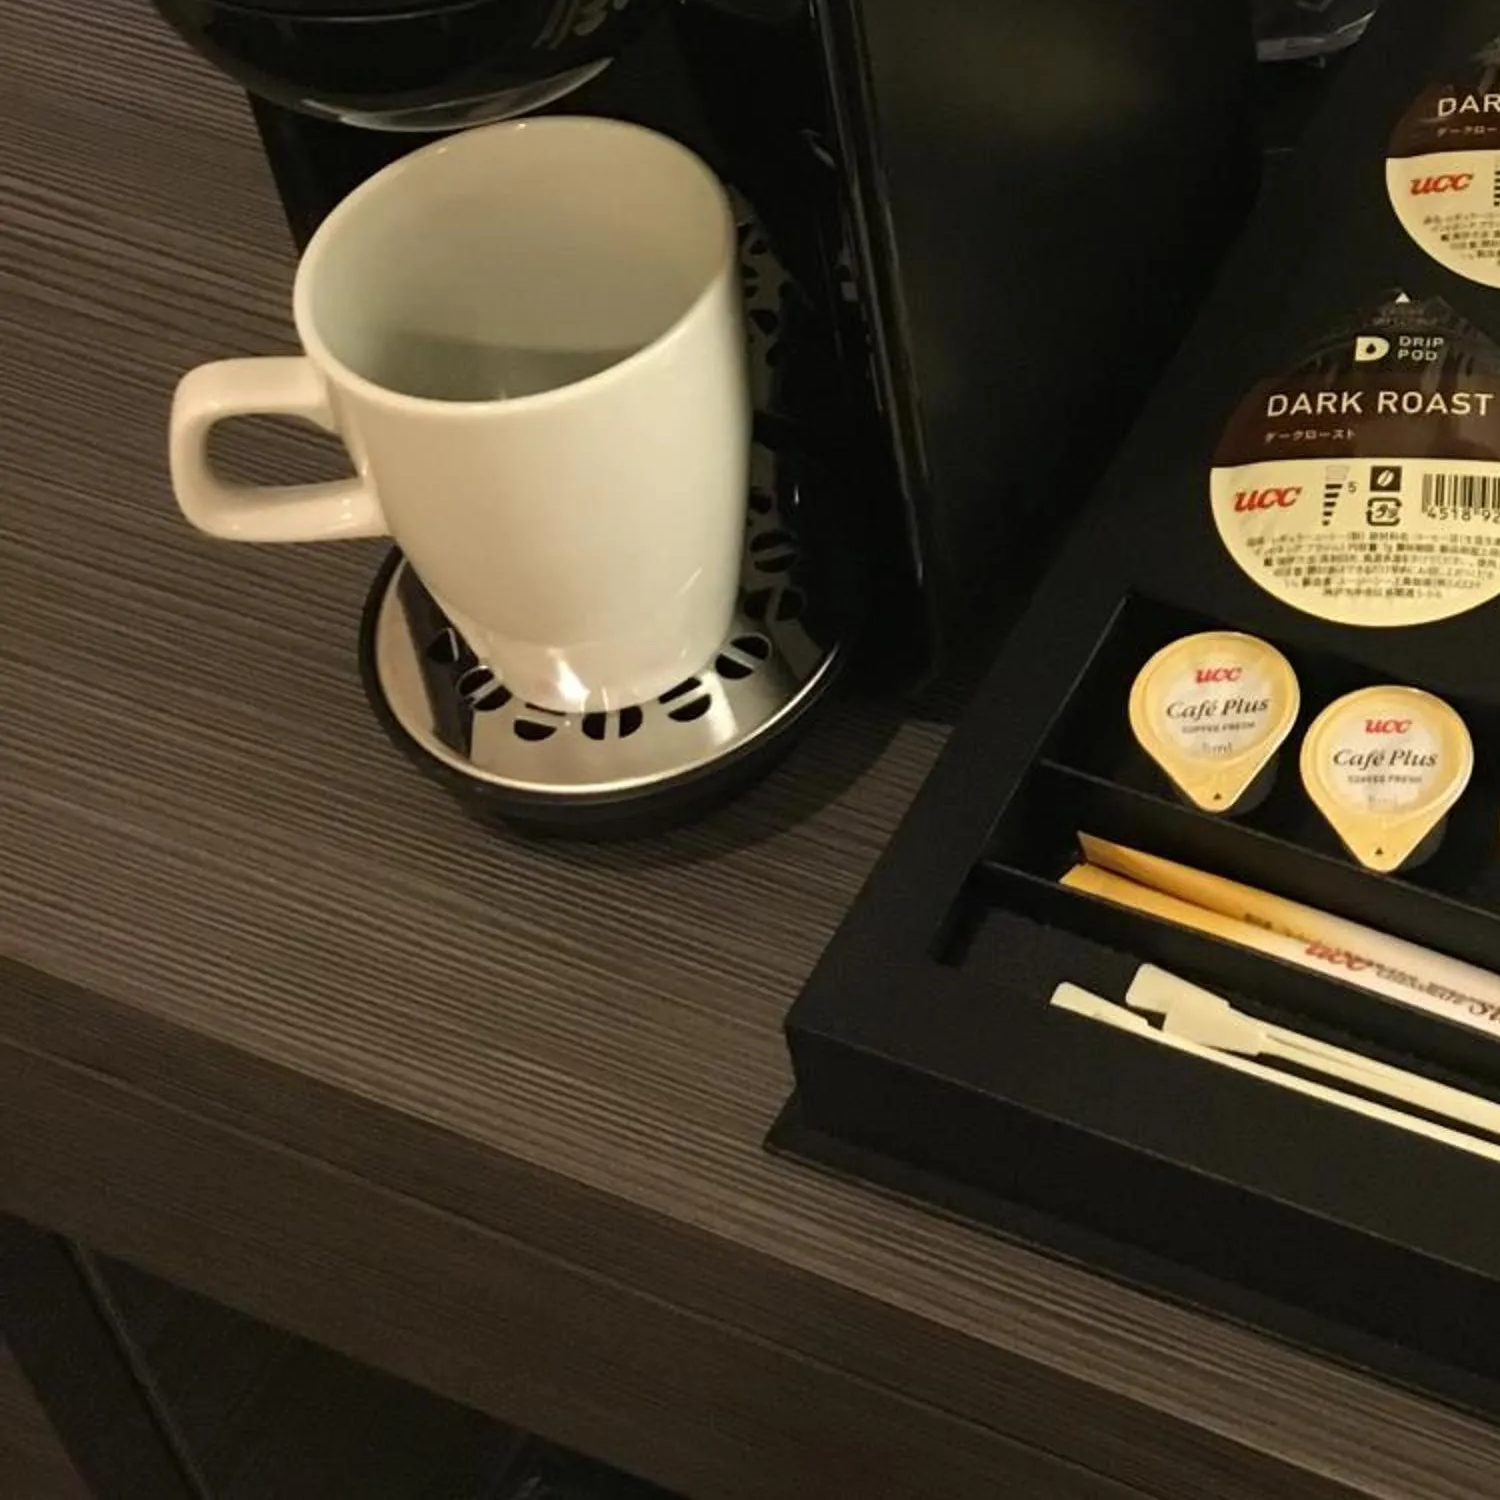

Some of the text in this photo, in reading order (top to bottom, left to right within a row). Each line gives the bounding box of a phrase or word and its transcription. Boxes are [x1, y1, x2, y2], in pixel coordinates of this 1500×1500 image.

[1399, 335, 1444, 348] DRIP
[1397, 349, 1438, 362] POD
[1266, 390, 1495, 418] DARK ROAST
[1426, 505, 1472, 522] 4518
[1166, 696, 1271, 722] Café Plus
[1332, 749, 1439, 772] Café Plus
